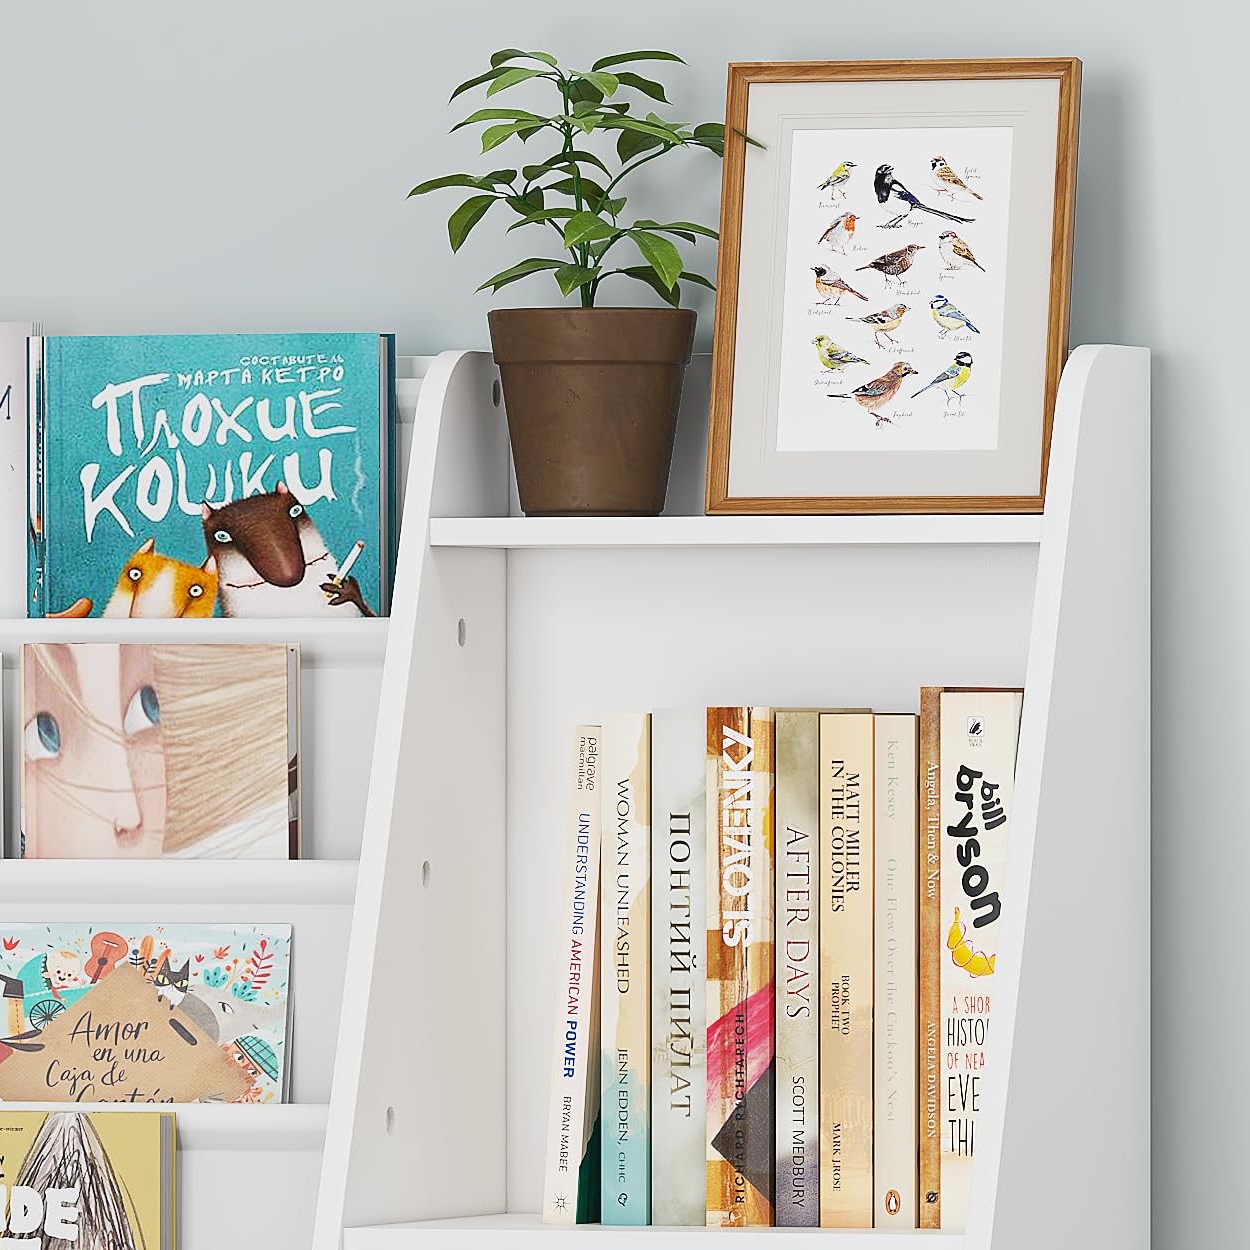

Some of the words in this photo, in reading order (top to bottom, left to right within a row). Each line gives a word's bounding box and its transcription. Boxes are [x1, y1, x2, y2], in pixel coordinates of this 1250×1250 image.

[262, 366, 344, 385] КЕТРО
[578, 736, 586, 790] macmillan
[586, 737, 598, 791] palgrave
[831, 760, 844, 778] IN
[887, 740, 898, 769] Ken
[831, 785, 844, 819] THE
[846, 773, 859, 823] MATT
[886, 776, 898, 820] Kesey
[925, 761, 939, 810] Angela,
[981, 781, 1007, 830] bill
[616, 778, 629, 866] WOMAN
[722, 725, 754, 947] SLOVENKY
[927, 816, 940, 854] Then
[947, 764, 1002, 928] bryson
[572, 813, 590, 935] UNDERSTANDING
[786, 826, 810, 927] AFTER
[831, 826, 844, 912] COLONIES
[846, 830, 859, 892] MILLER
[887, 858, 896, 890] One
[927, 855, 939, 864] &
[669, 812, 696, 973] ПОНТИЙ
[927, 869, 940, 900] Now
[616, 874, 630, 994] UNLEASHED
[887, 898, 897, 931] Flew
[567, 939, 582, 1015] AMERICAN
[786, 940, 810, 1018] DAYS
[887, 938, 896, 976] Over
[831, 982, 839, 1031] PROPHET
[886, 981, 897, 1004] the
[952, 996, 958, 1014] A
[68, 1011, 150, 1048] Amor
[563, 1020, 577, 1078] POWER
[670, 988, 693, 1117] ПИЛАТ
[886, 1012, 897, 1081] Cuckoo's
[927, 1021, 936, 1072] ANGELA
[947, 1018, 990, 1046] HISTO
[46, 1060, 94, 1094] Caja
[102, 1062, 126, 1087] de
[93, 1047, 116, 1062] en
[124, 1047, 164, 1062] una
[617, 1048, 628, 1084] JENN
[735, 1014, 745, 1120] RYCHTARECH
[947, 1052, 959, 1070] OF
[561, 1096, 572, 1131] BRYAN
[617, 1090, 628, 1145] EDDEN,
[792, 1076, 804, 1124] SCOTT
[886, 1089, 897, 1121] Nest
[927, 1075, 936, 1138] DAVIDSON
[559, 1134, 569, 1172] MABEE
[832, 1122, 841, 1156] MARK
[735, 1130, 745, 1204] RICHARD
[792, 1130, 804, 1208] MEDBURY
